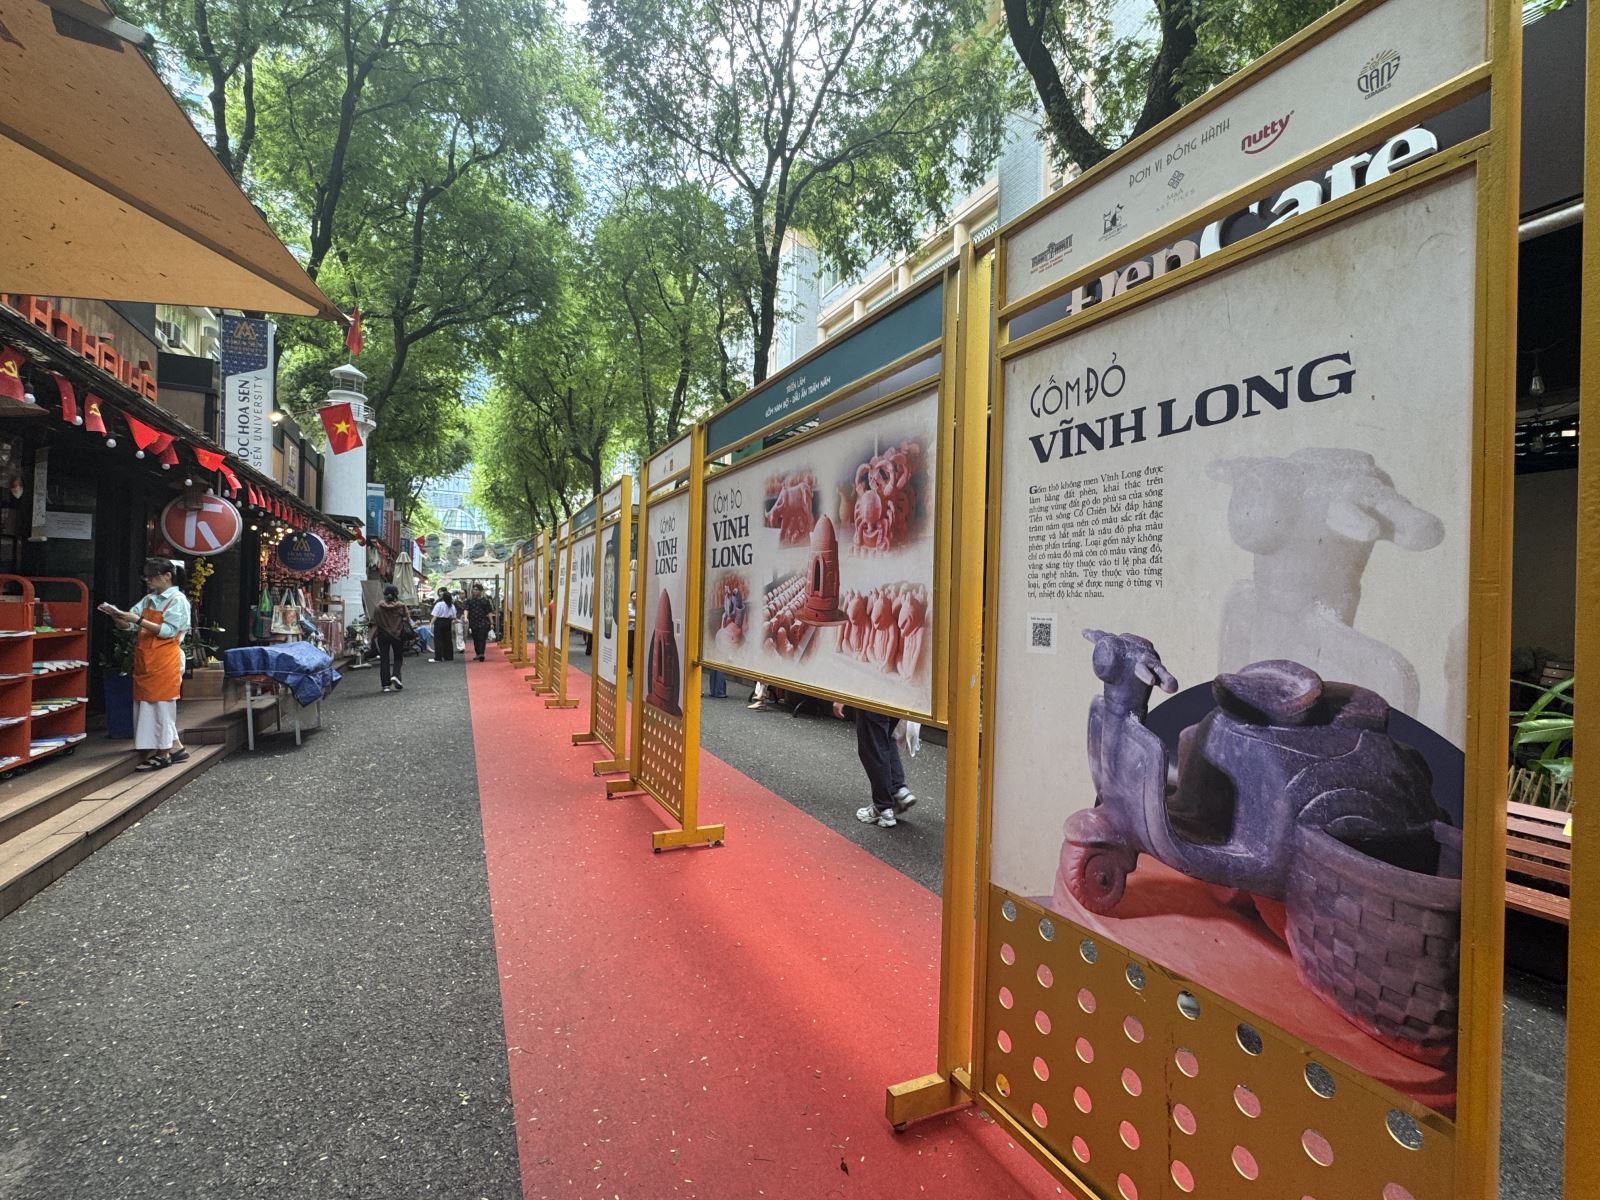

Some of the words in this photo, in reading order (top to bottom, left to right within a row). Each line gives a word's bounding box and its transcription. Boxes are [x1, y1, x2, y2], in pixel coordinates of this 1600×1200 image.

[1166, 138, 1197, 166] ĐỒNG
[1201, 117, 1230, 145] HÀNH
[1241, 114, 1291, 154] nutty
[238, 379, 250, 404] SEN
[1030, 374, 1080, 418] GỐM
[1085, 352, 1126, 405] ĐỎ
[238, 406, 250, 435] HOA
[253, 375, 263, 441] UNIVERSITY
[1029, 406, 1147, 463] VĨNH
[1157, 350, 1357, 438] LONG
[253, 446, 263, 467] SEN
[712, 514, 749, 542] VĨNH
[657, 536, 678, 557] VĨNH
[712, 543, 753, 568] LONG
[655, 556, 678, 575] LONG
